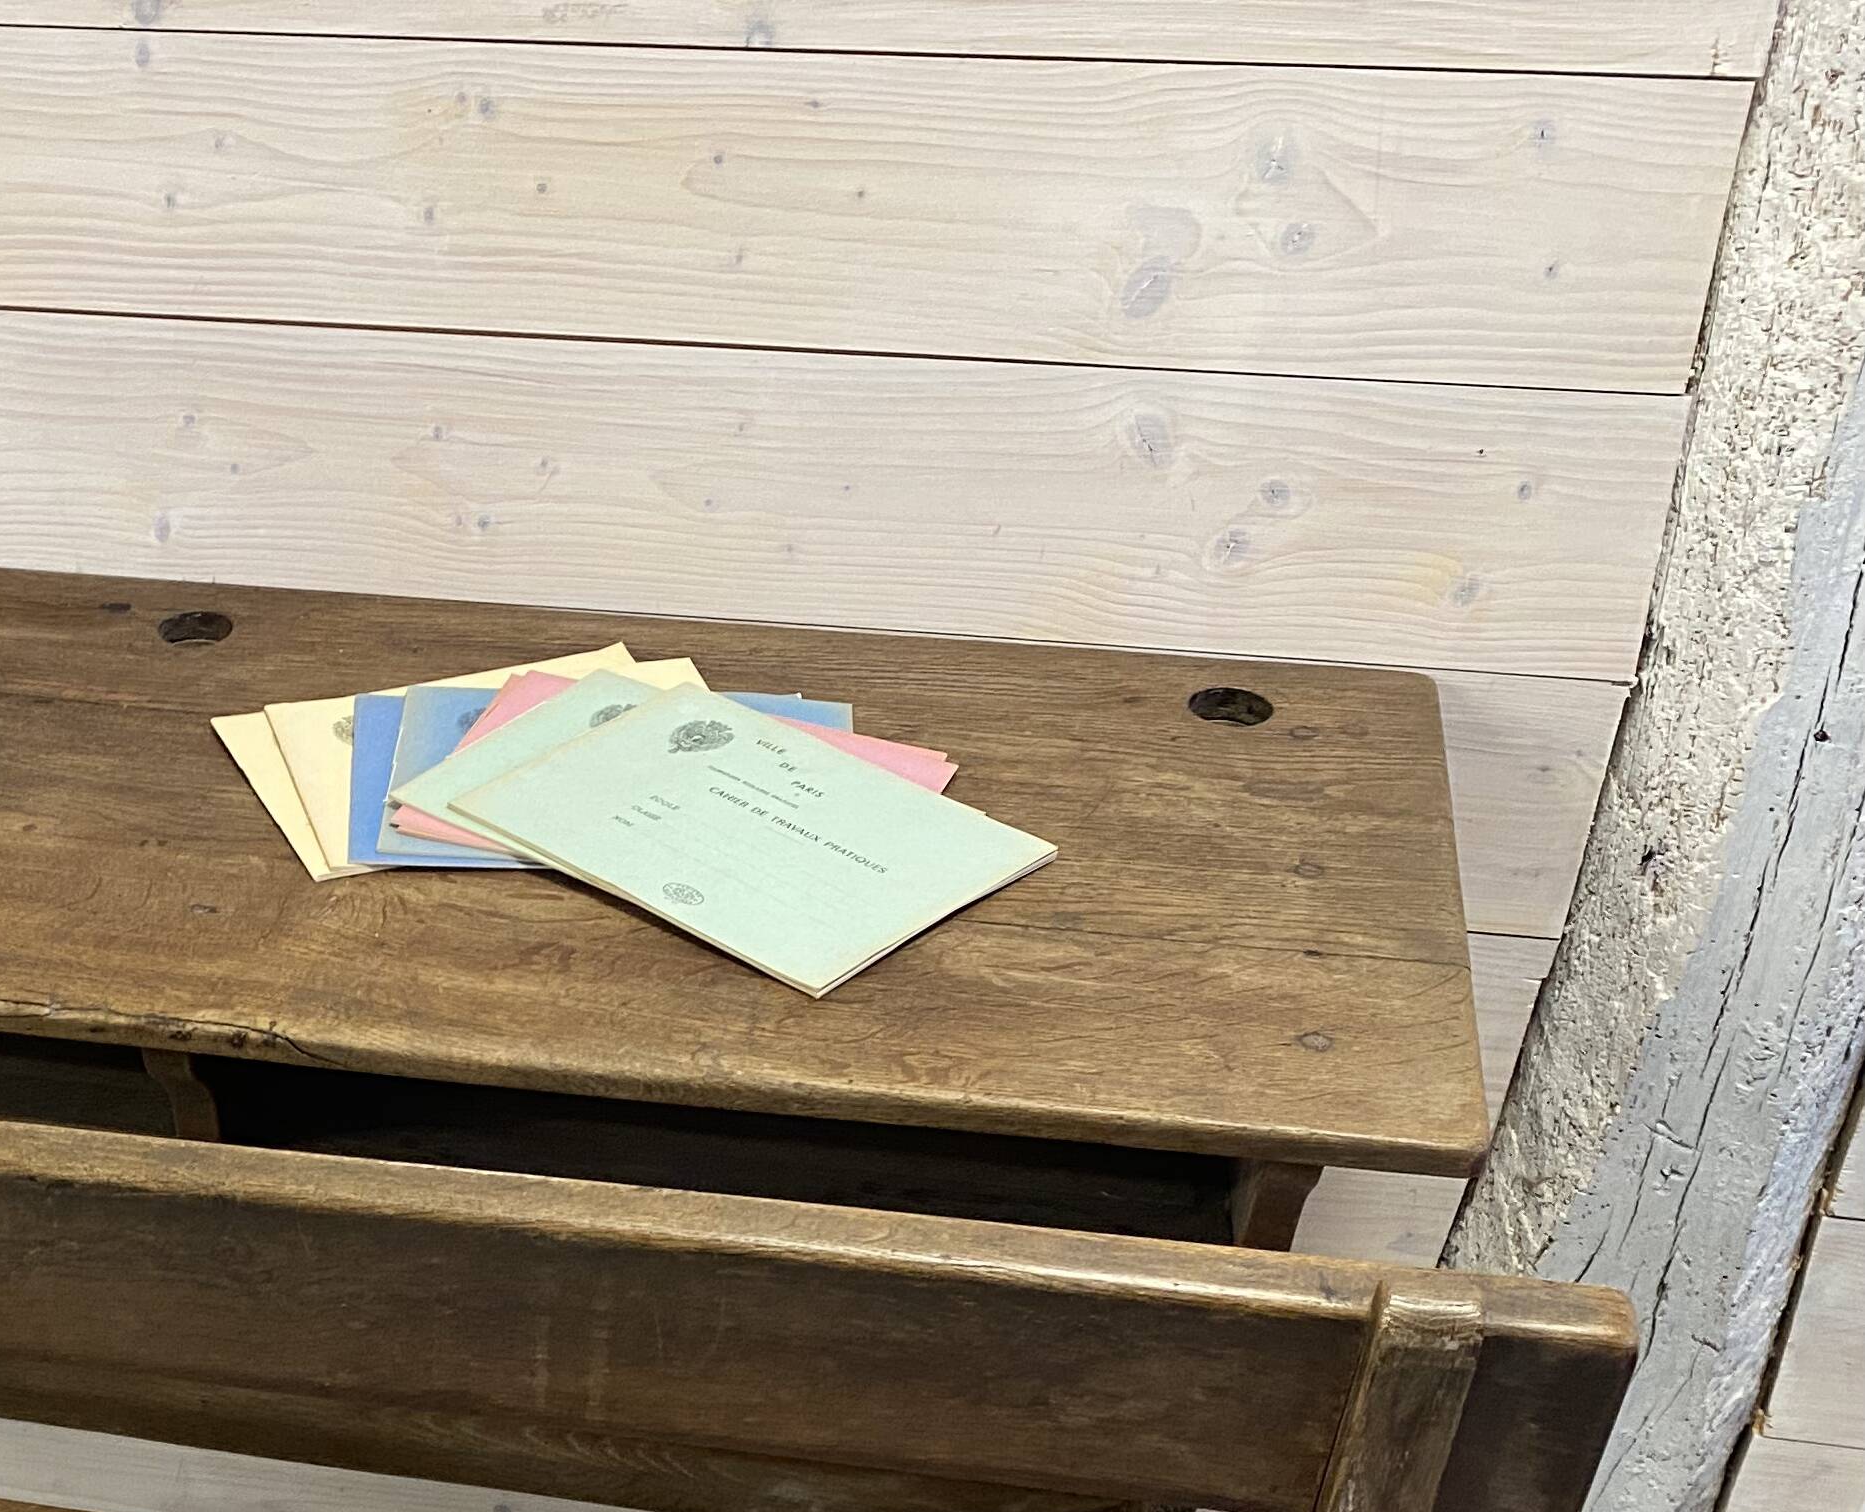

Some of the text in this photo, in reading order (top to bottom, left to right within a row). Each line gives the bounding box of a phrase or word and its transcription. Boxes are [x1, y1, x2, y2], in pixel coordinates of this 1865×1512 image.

[756, 739, 788, 755] VILLE
[778, 761, 797, 773] DE
[790, 780, 826, 798] PARIS
[708, 786, 750, 808] CAHIER
[750, 806, 770, 816] DE
[770, 815, 822, 842] TRAVAUX
[823, 841, 888, 874] PRATIQUES
